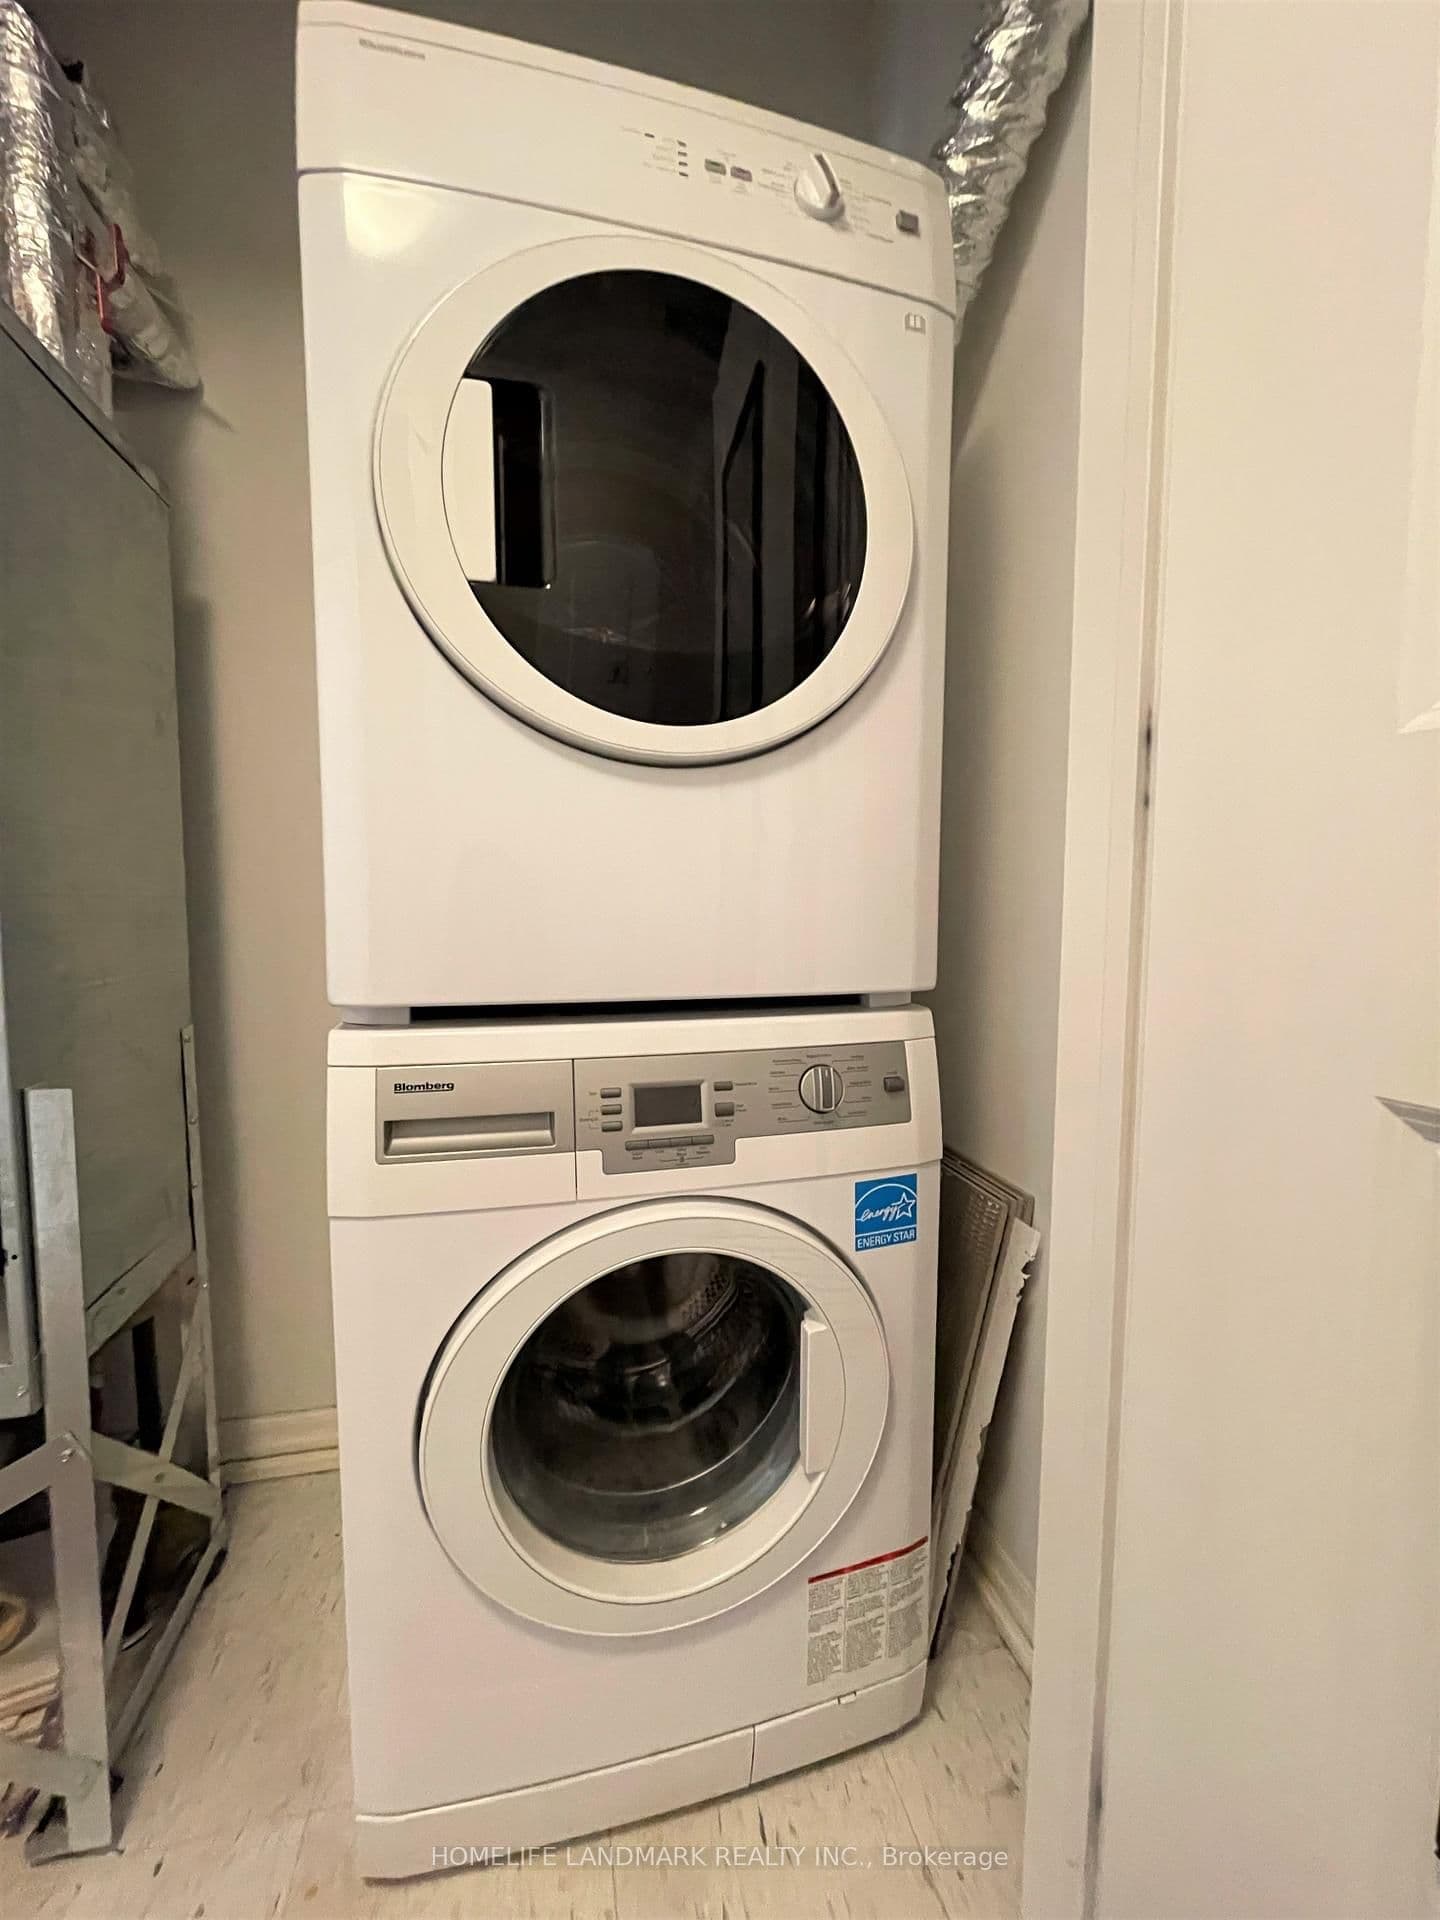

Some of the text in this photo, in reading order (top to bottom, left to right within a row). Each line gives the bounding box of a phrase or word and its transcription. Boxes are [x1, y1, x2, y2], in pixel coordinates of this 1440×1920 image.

[394, 1082, 455, 1094] Blomberg
[860, 1205, 898, 1222] energy
[857, 1229, 915, 1248] ENERGY STAR
